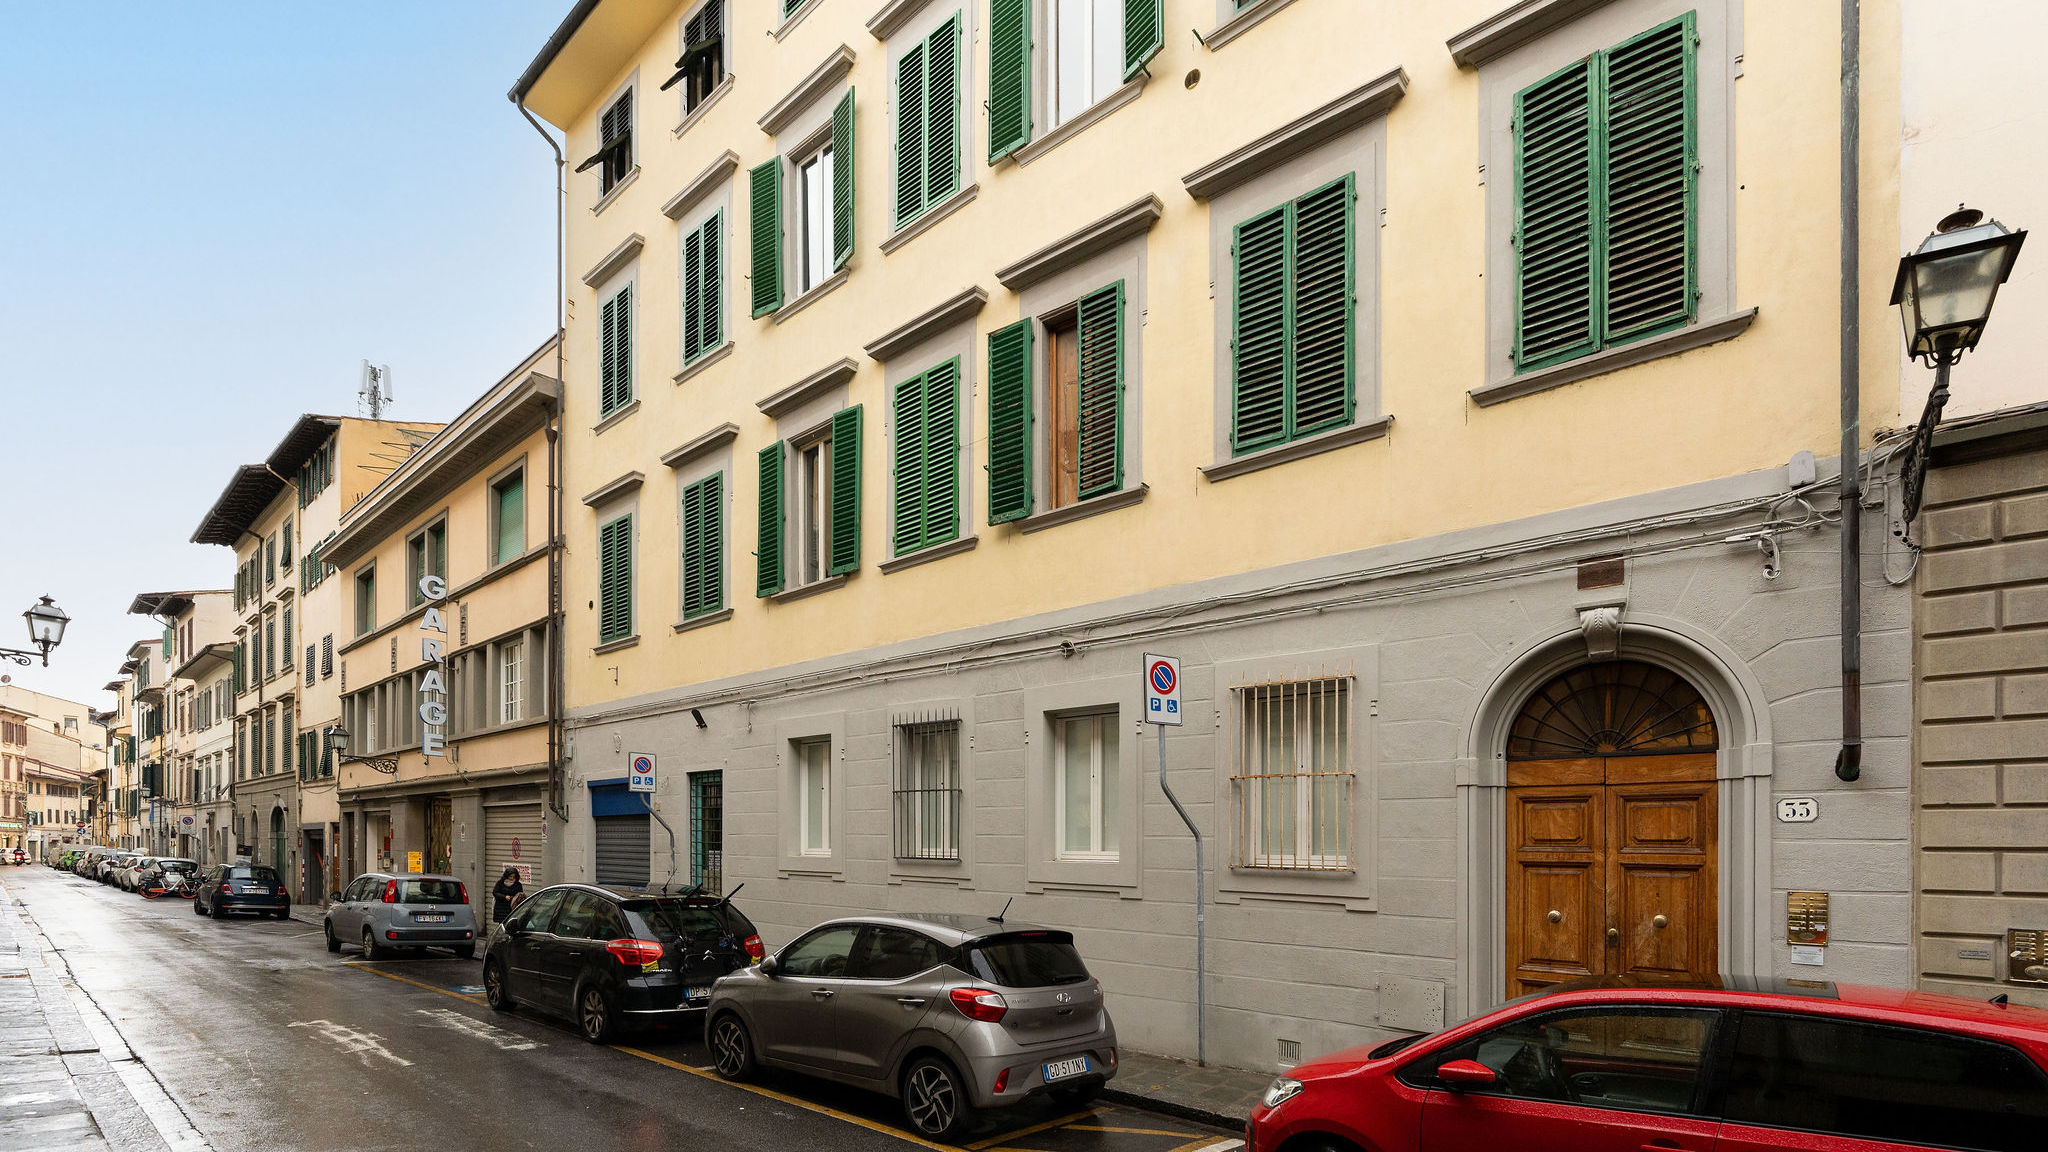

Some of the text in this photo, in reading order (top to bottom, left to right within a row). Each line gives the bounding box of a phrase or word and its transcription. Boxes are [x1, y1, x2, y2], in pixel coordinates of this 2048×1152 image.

[419, 575, 447, 756] GARAGE
[1152, 699, 1160, 710] P
[1785, 802, 1811, 818] 33
